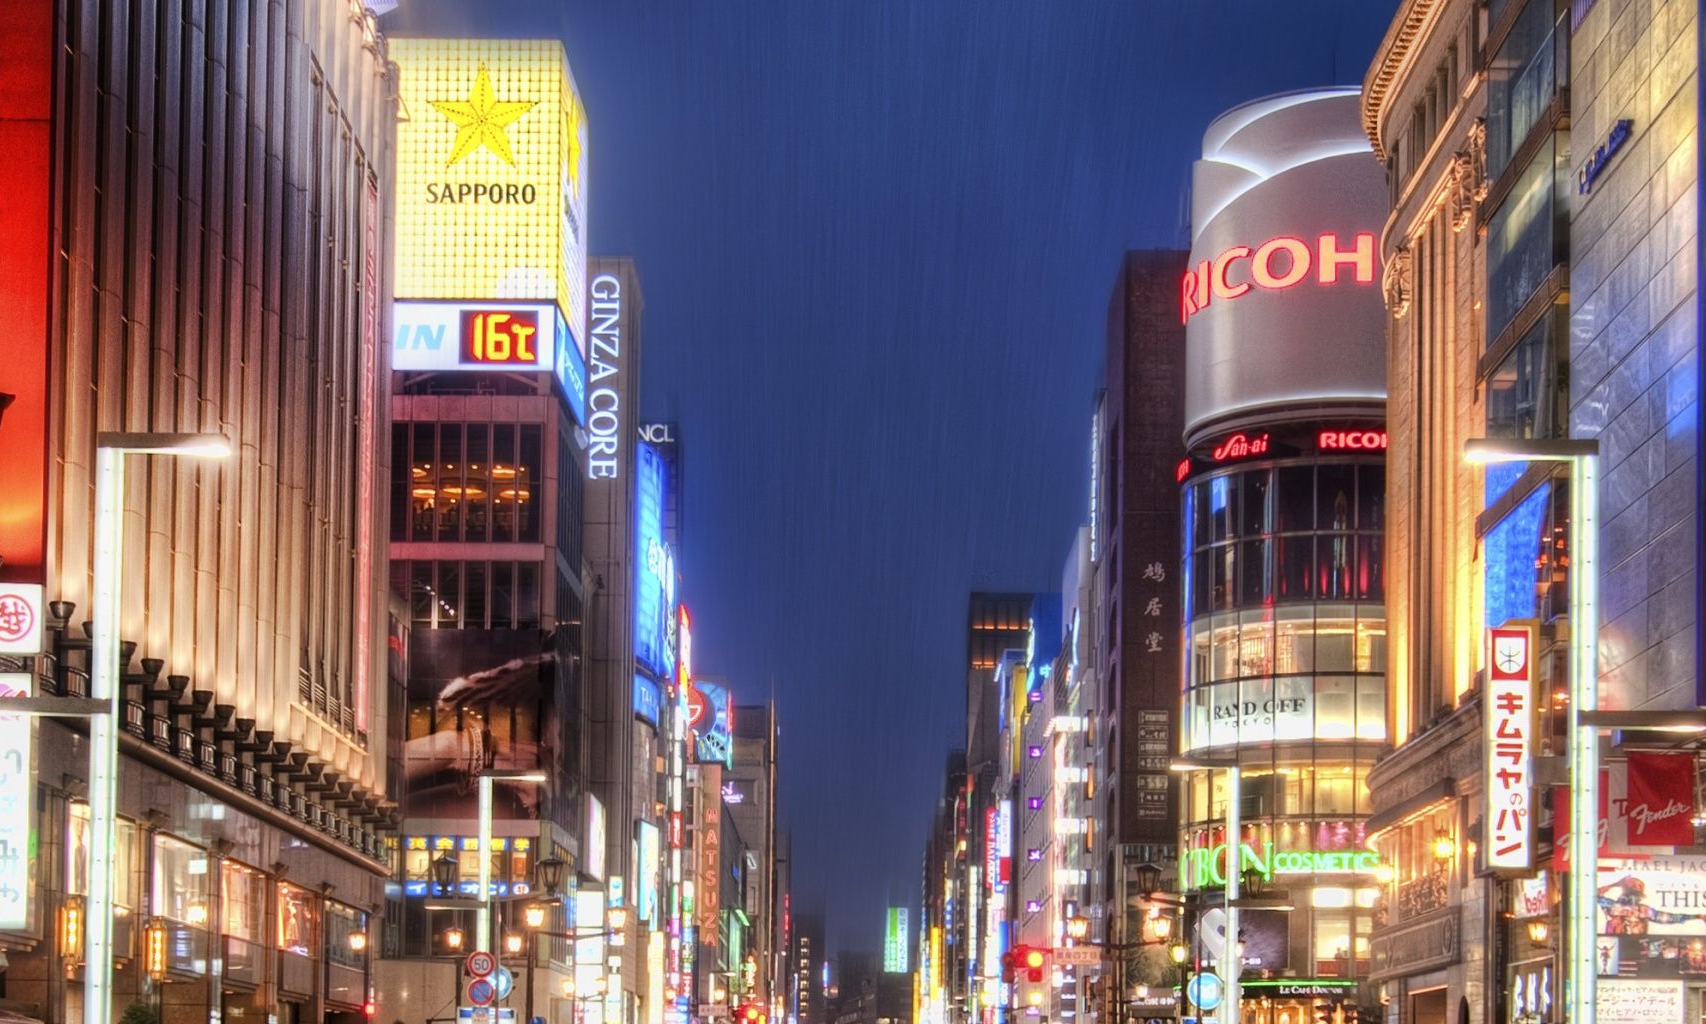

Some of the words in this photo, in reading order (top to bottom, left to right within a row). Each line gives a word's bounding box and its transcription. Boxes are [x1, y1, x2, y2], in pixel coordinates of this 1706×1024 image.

[425, 183, 537, 205] SAPPORO
[1179, 231, 1375, 326] RICOH
[590, 274, 620, 383] GINZA
[588, 388, 619, 480] CORE
[1495, 693, 1528, 857] キムラヤのパン
[1629, 799, 1692, 836] Fender
[473, 958, 490, 971] 50
